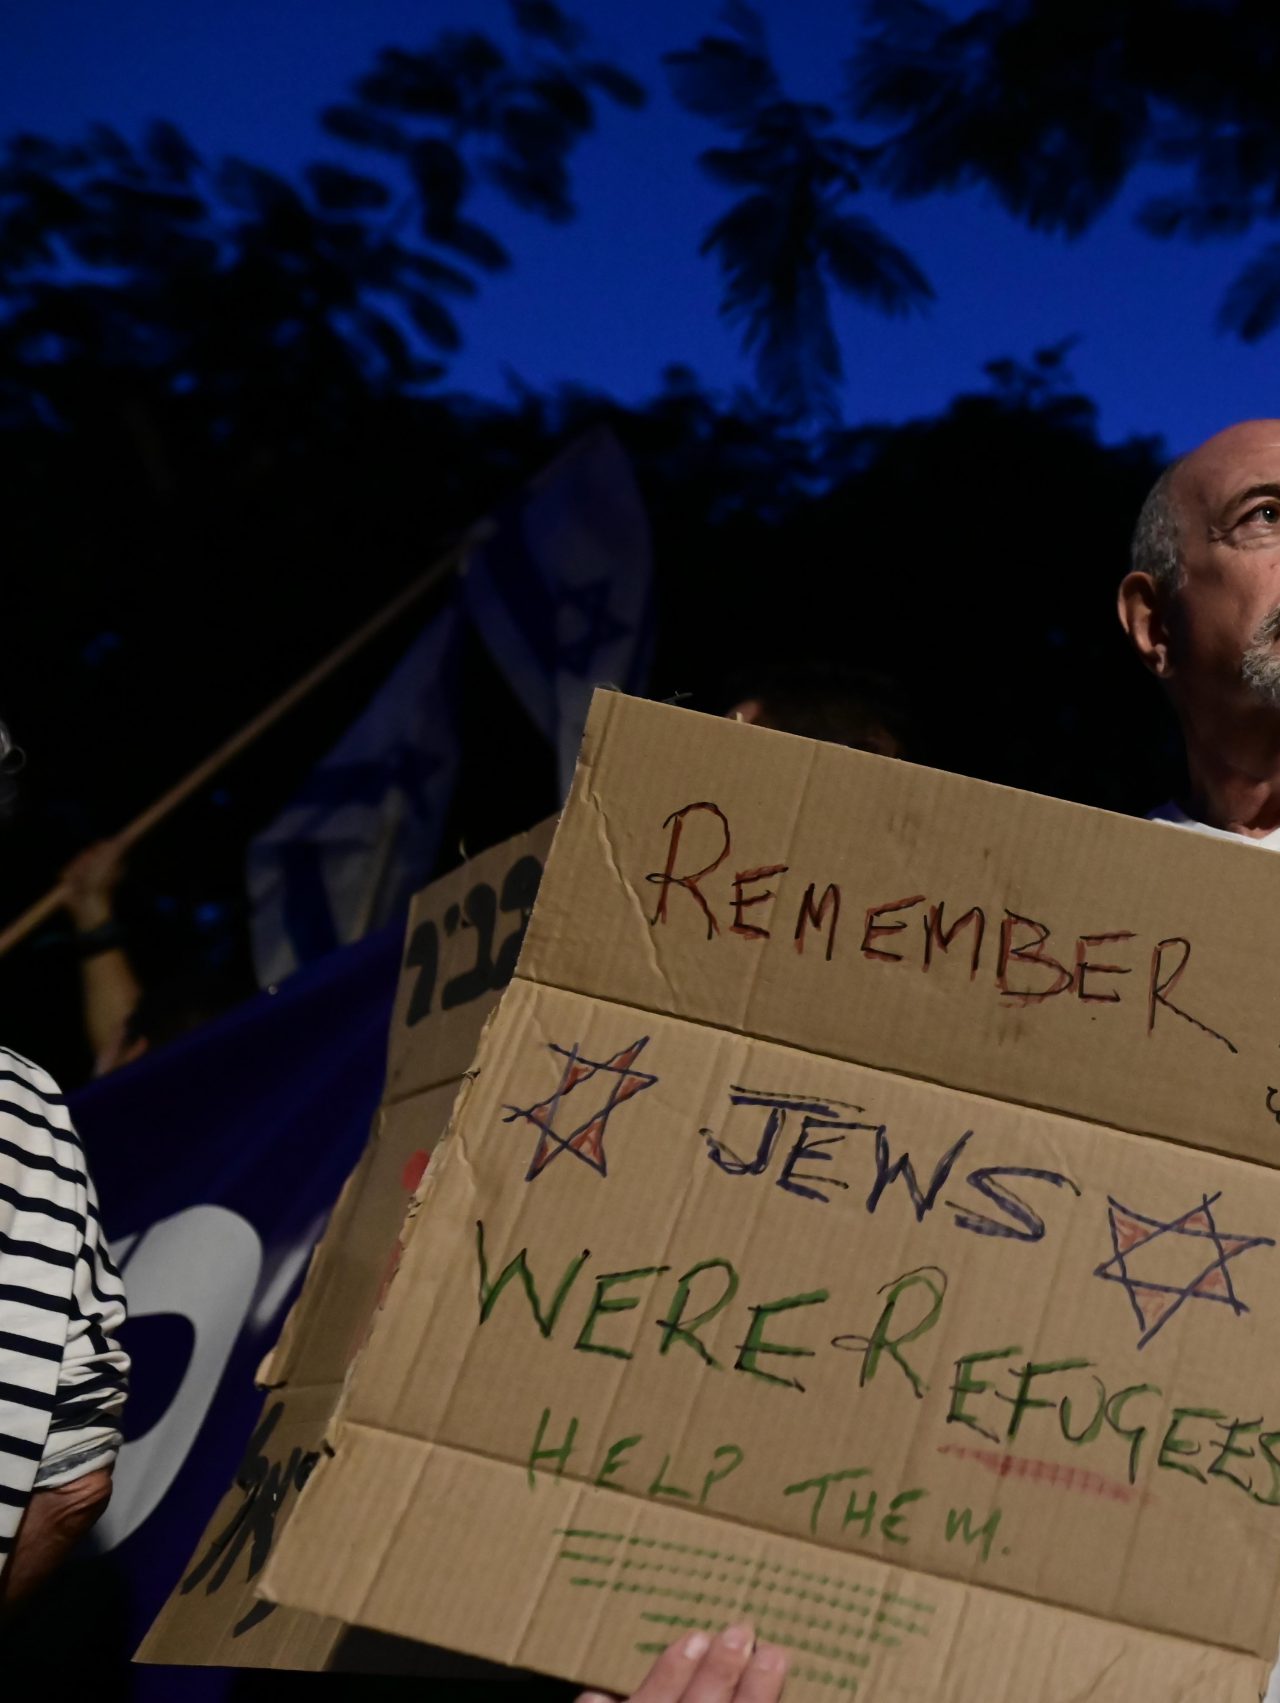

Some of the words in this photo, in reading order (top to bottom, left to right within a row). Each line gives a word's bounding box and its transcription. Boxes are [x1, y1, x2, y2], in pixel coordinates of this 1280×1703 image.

[646, 802, 1237, 1053] REMEMBER
[699, 1085, 1082, 1242] JEWS
[475, 1220, 828, 1392] WERE
[526, 1407, 745, 1505] HELP
